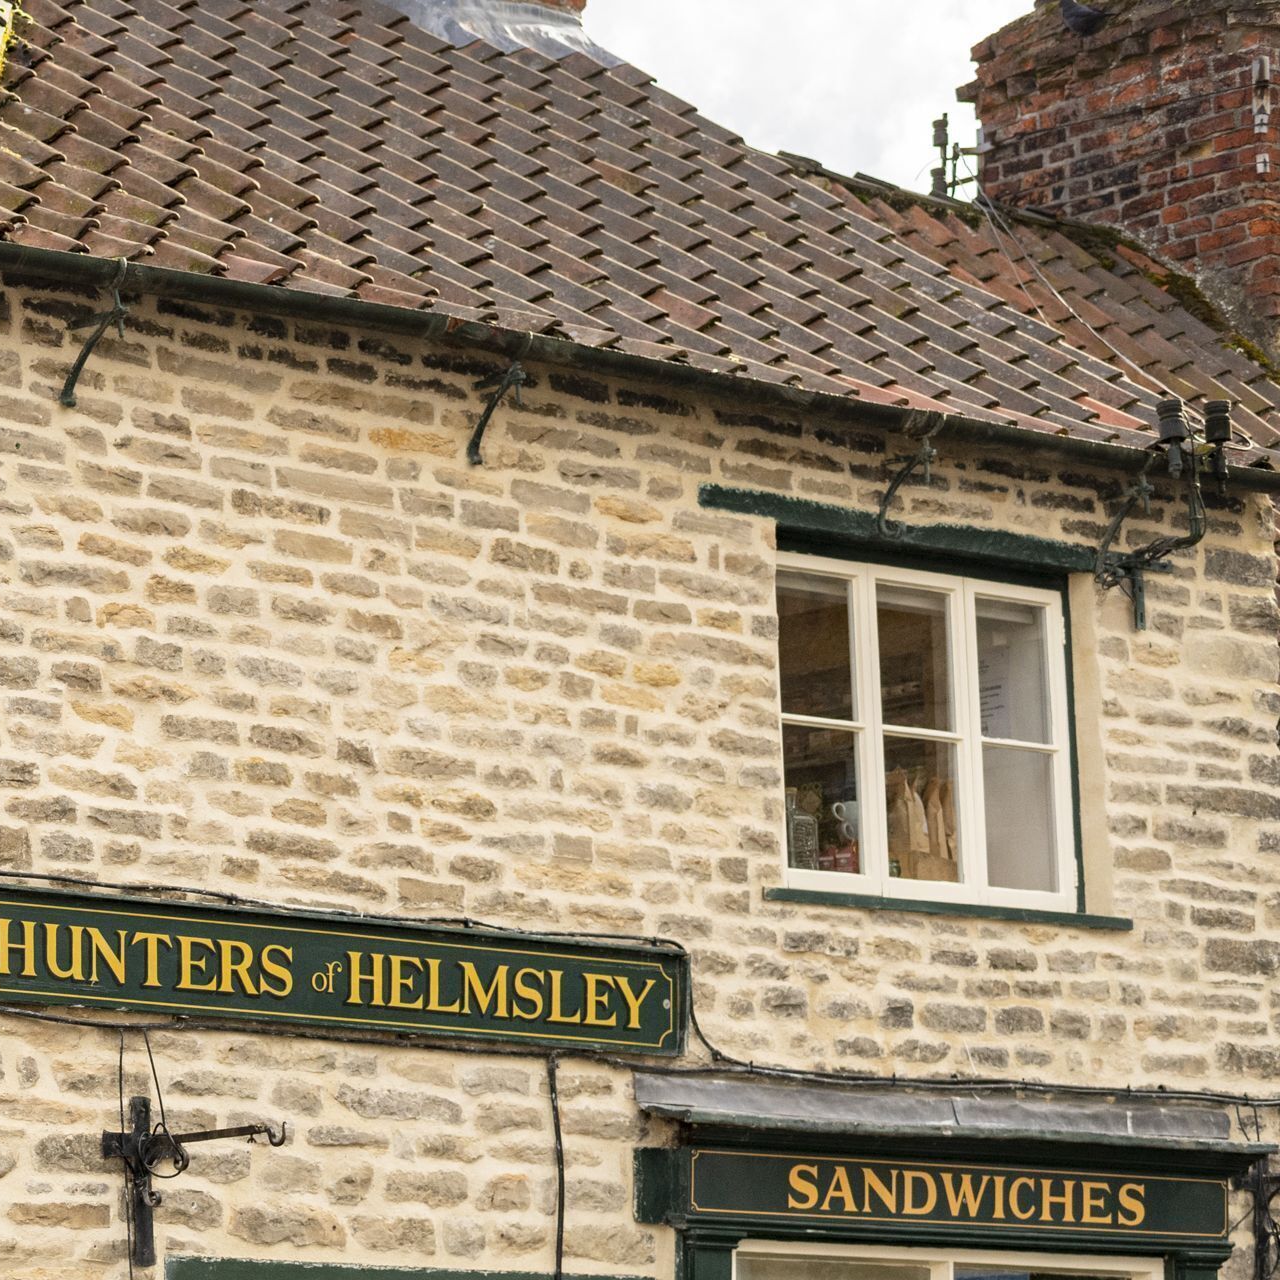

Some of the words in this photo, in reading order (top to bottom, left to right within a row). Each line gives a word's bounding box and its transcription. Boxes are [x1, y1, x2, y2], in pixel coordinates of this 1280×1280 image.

[311, 960, 342, 994] of
[345, 950, 656, 1029] HELMSLEY
[787, 1164, 1146, 1226] SANDWICHES
